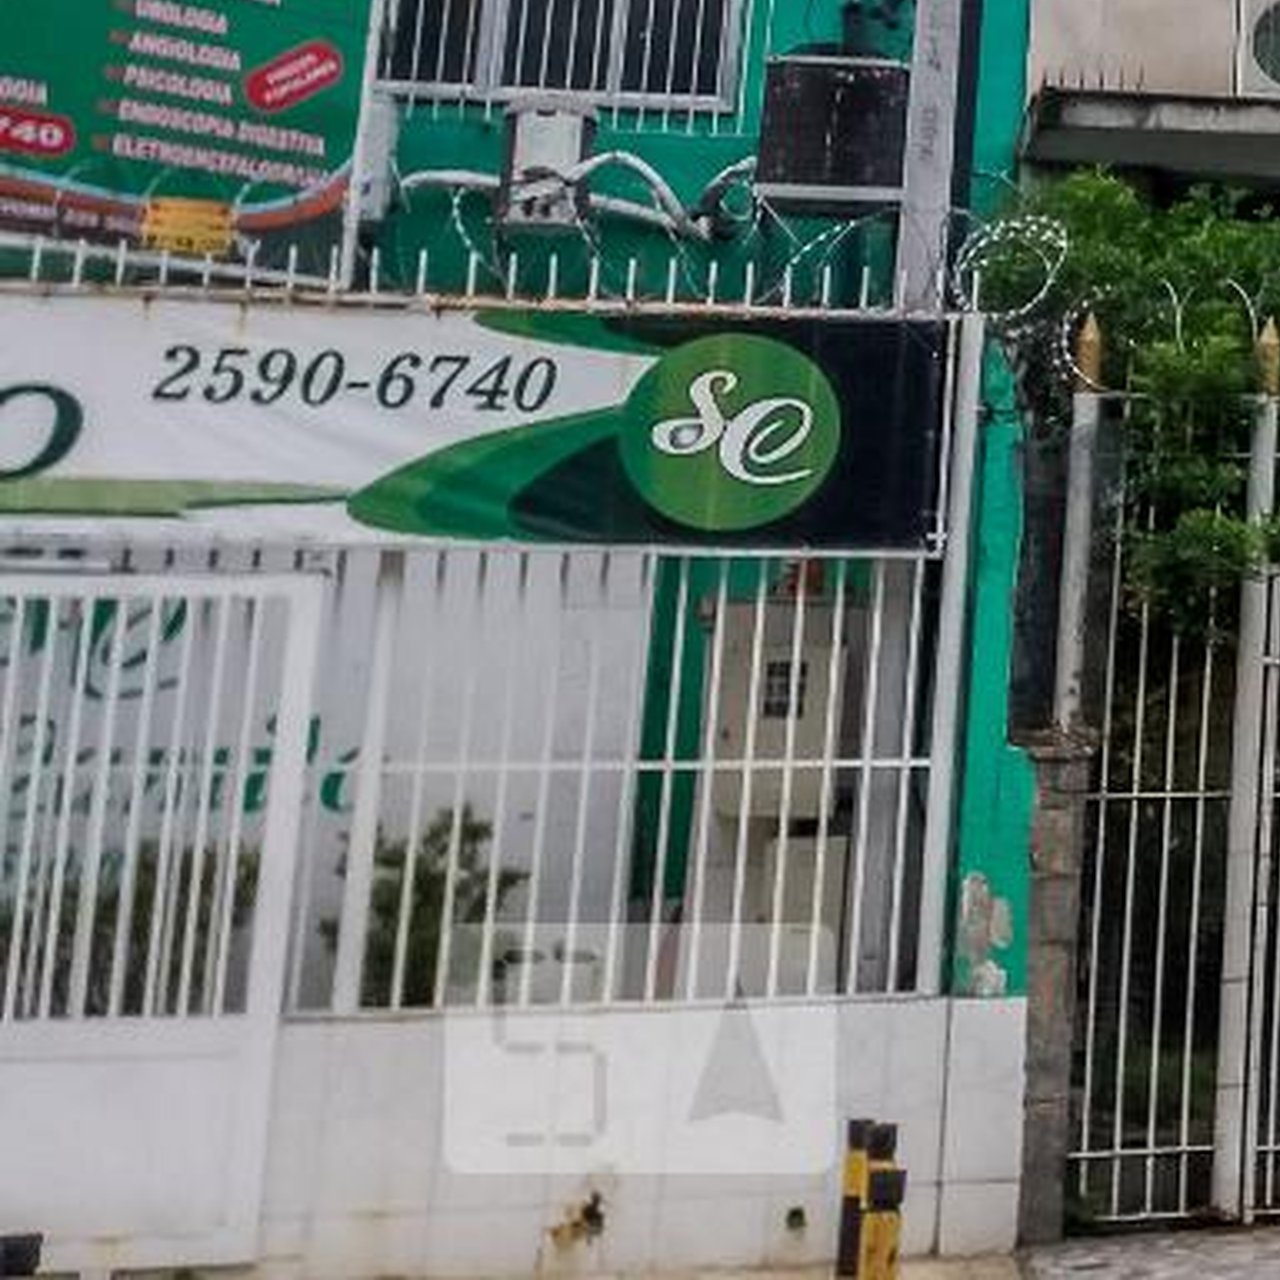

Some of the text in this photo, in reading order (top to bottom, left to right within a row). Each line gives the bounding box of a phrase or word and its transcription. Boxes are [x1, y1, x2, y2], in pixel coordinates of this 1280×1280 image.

[129, 32, 240, 71] ANGIOLOGIA
[124, 66, 232, 105] PSICOLOGIA
[152, 344, 559, 415] 2590-6740
